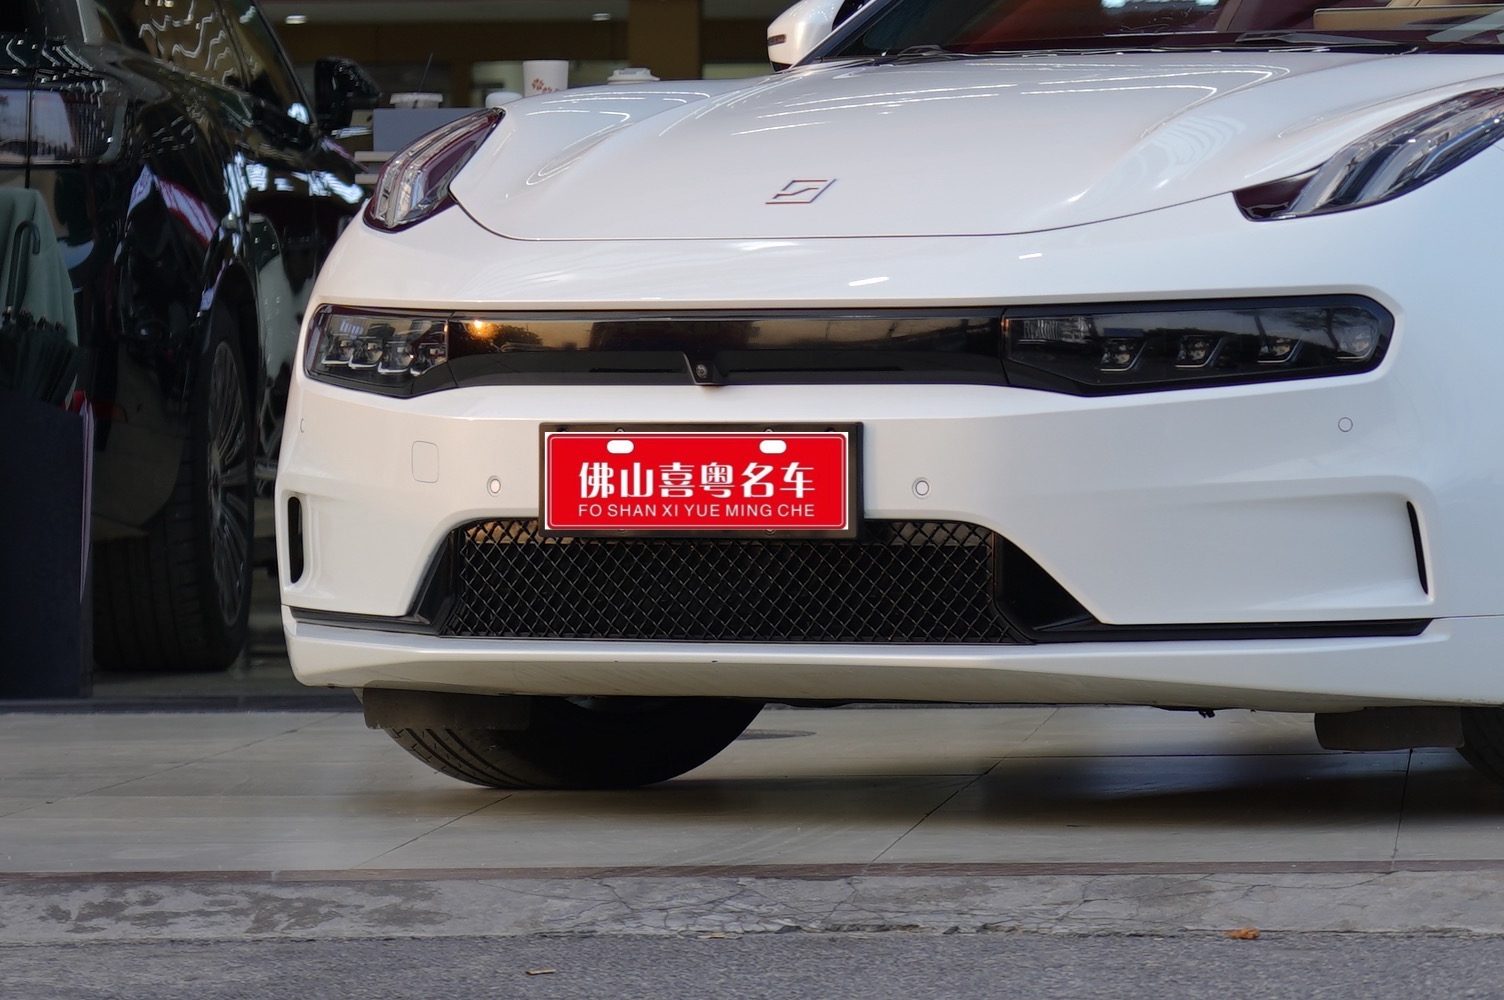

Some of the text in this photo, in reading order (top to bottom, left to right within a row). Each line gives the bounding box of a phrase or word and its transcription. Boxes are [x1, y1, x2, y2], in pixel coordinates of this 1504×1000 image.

[578, 461, 816, 498] 佛山喜粤名车
[578, 504, 815, 517] FO SHAN XI YUE MING CHE
